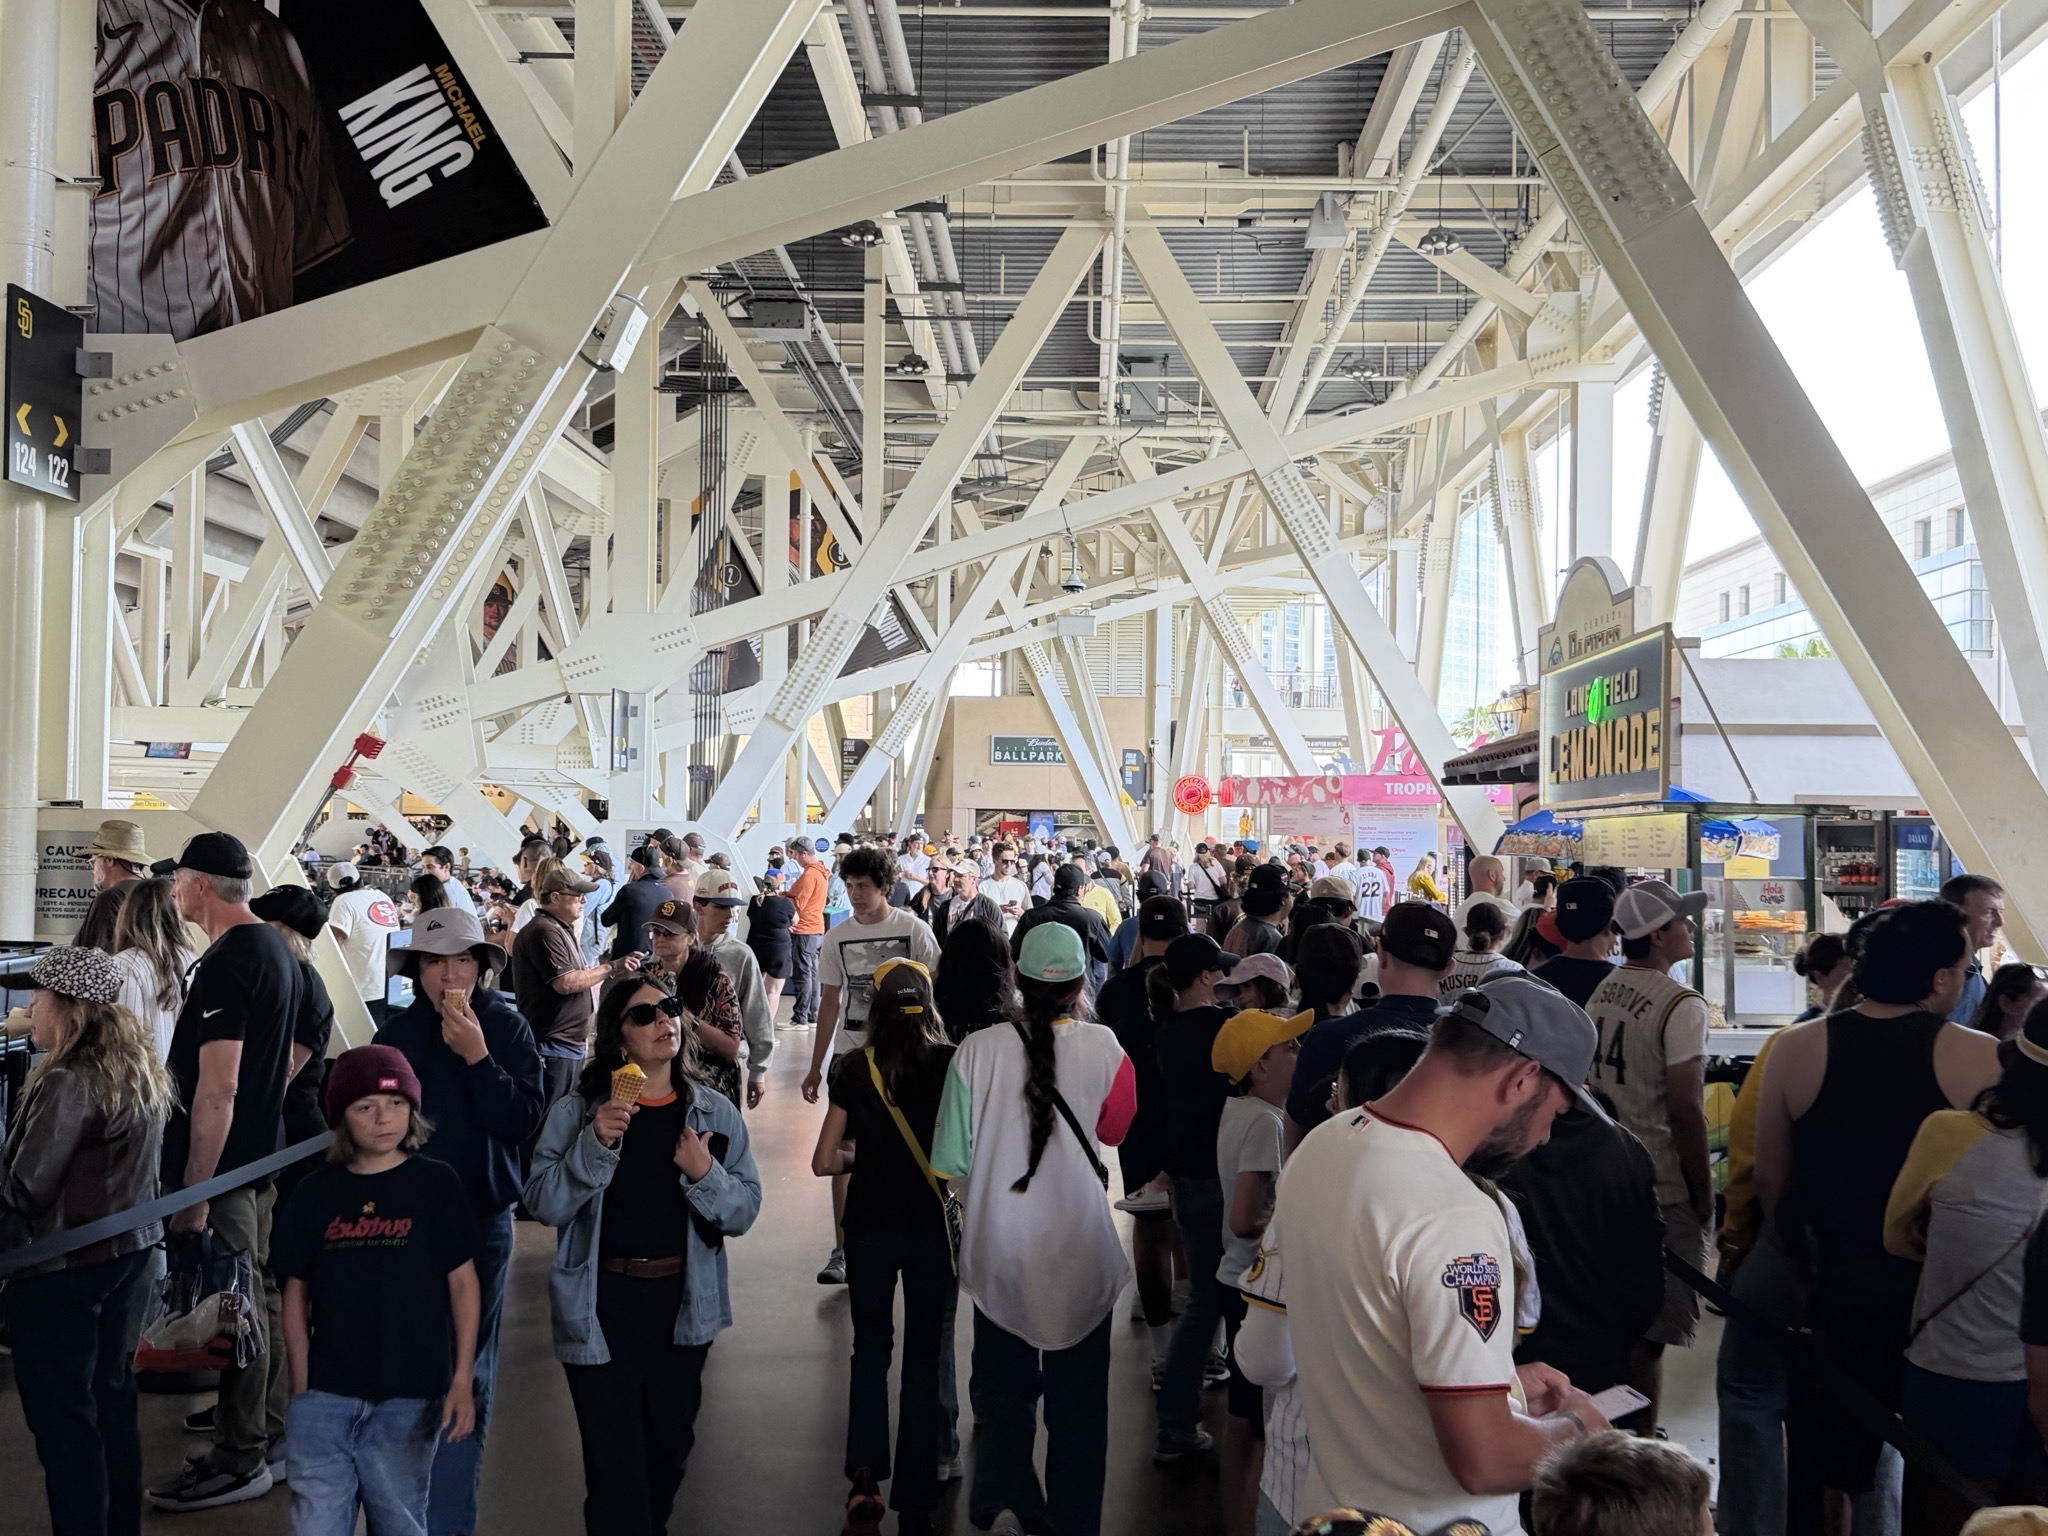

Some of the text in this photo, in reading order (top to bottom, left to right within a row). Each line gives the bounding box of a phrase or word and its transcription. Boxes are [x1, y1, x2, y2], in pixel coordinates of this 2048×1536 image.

[434, 63, 486, 150] MICHAEL
[93, 77, 312, 199] PADR
[338, 63, 474, 209] KING
[15, 442, 69, 488] 124 122
[728, 568, 734, 583] 2
[1584, 610, 1621, 631] CERVEZA
[1603, 666, 1639, 707] FIELD
[994, 751, 1063, 761] BALLPARK
[1550, 708, 1660, 784] LEMONADE
[1362, 881, 1381, 898] 22
[1763, 883, 1783, 896] Hola
[1438, 974, 1479, 995] MUSGR
[1593, 982, 1653, 1020] SGROVE
[1449, 1264, 1484, 1275] WORLD
